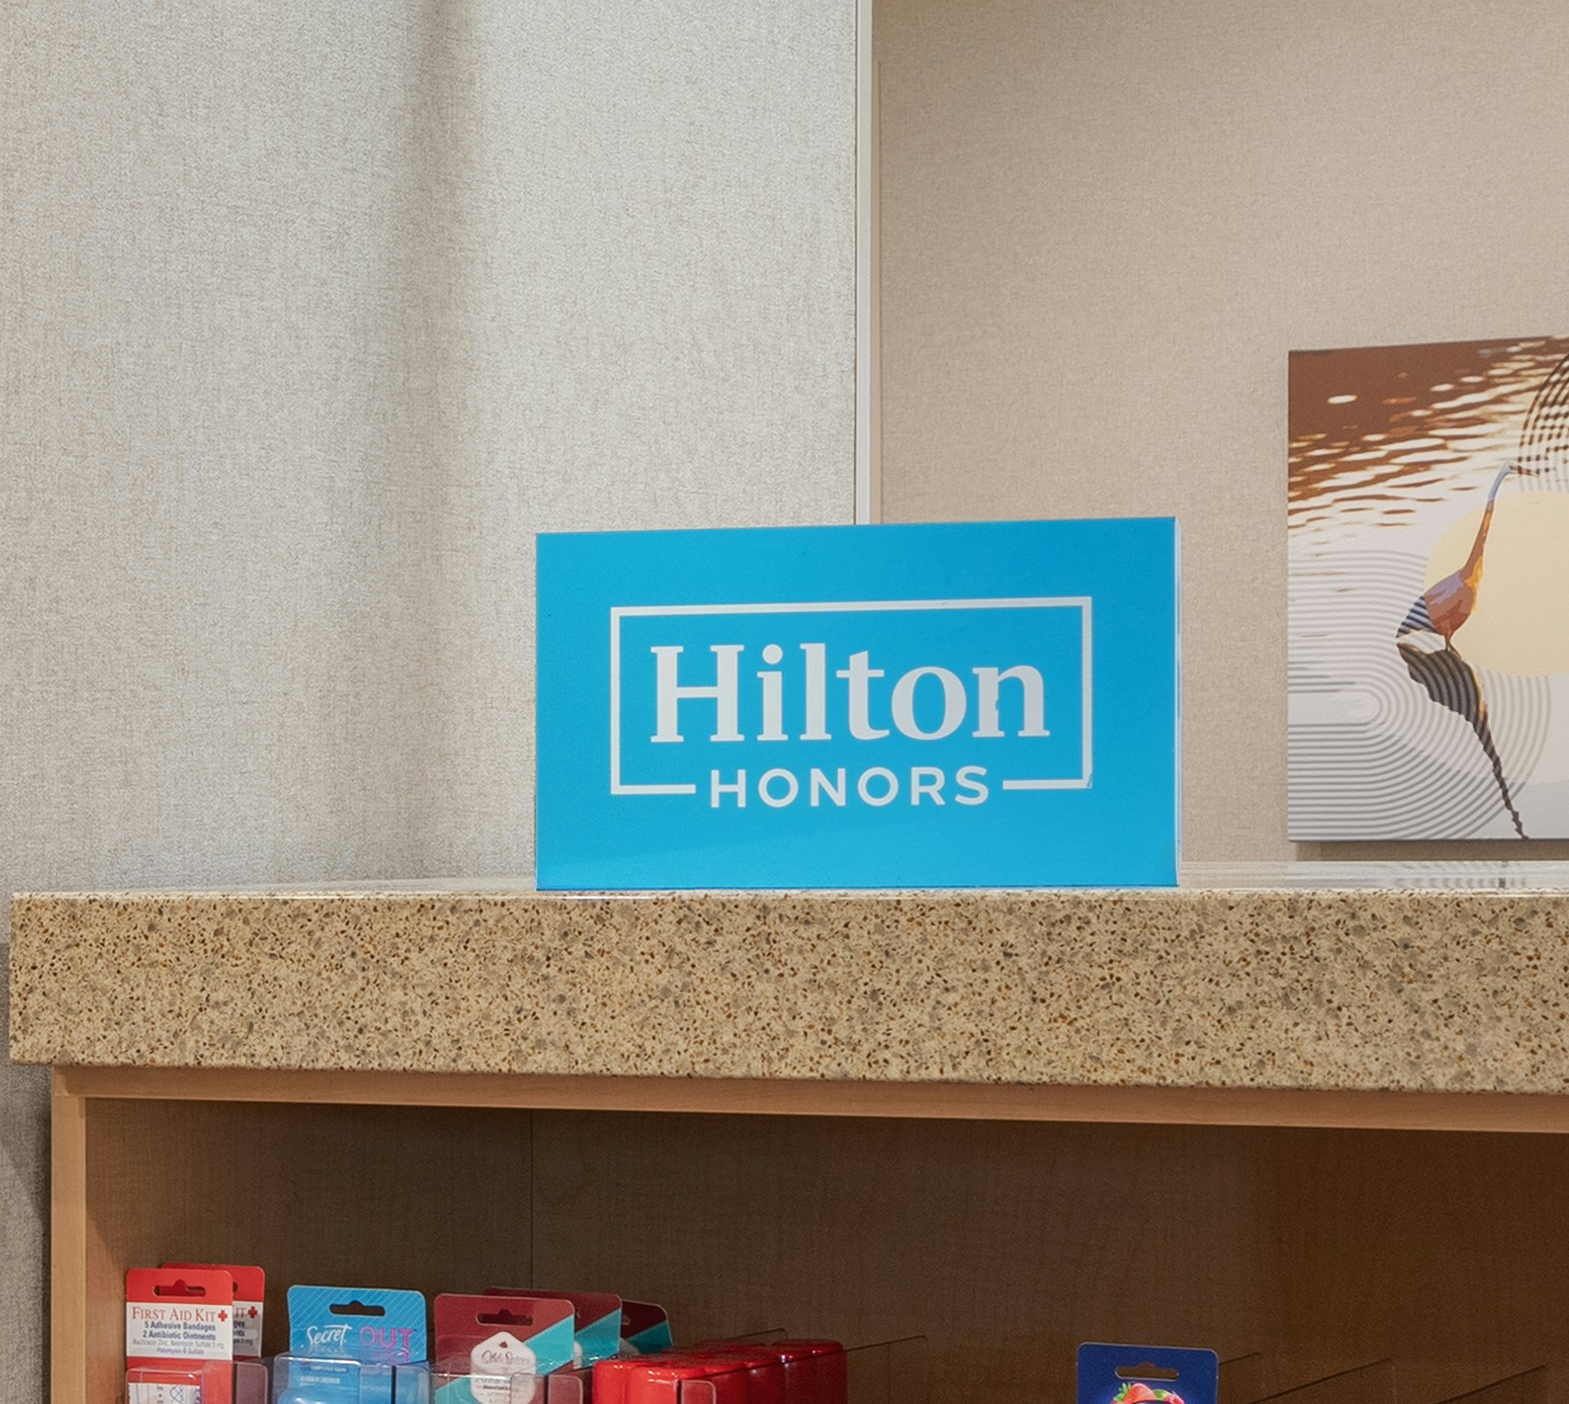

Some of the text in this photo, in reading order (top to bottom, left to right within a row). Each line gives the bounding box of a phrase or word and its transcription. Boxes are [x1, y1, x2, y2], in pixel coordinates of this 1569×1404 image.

[650, 643, 1050, 742] Hilton
[710, 766, 989, 808] HONORS
[132, 1307, 216, 1322] FIRST AID KIT
[183, 1322, 216, 1331] Bandages
[306, 1324, 352, 1347] Secret
